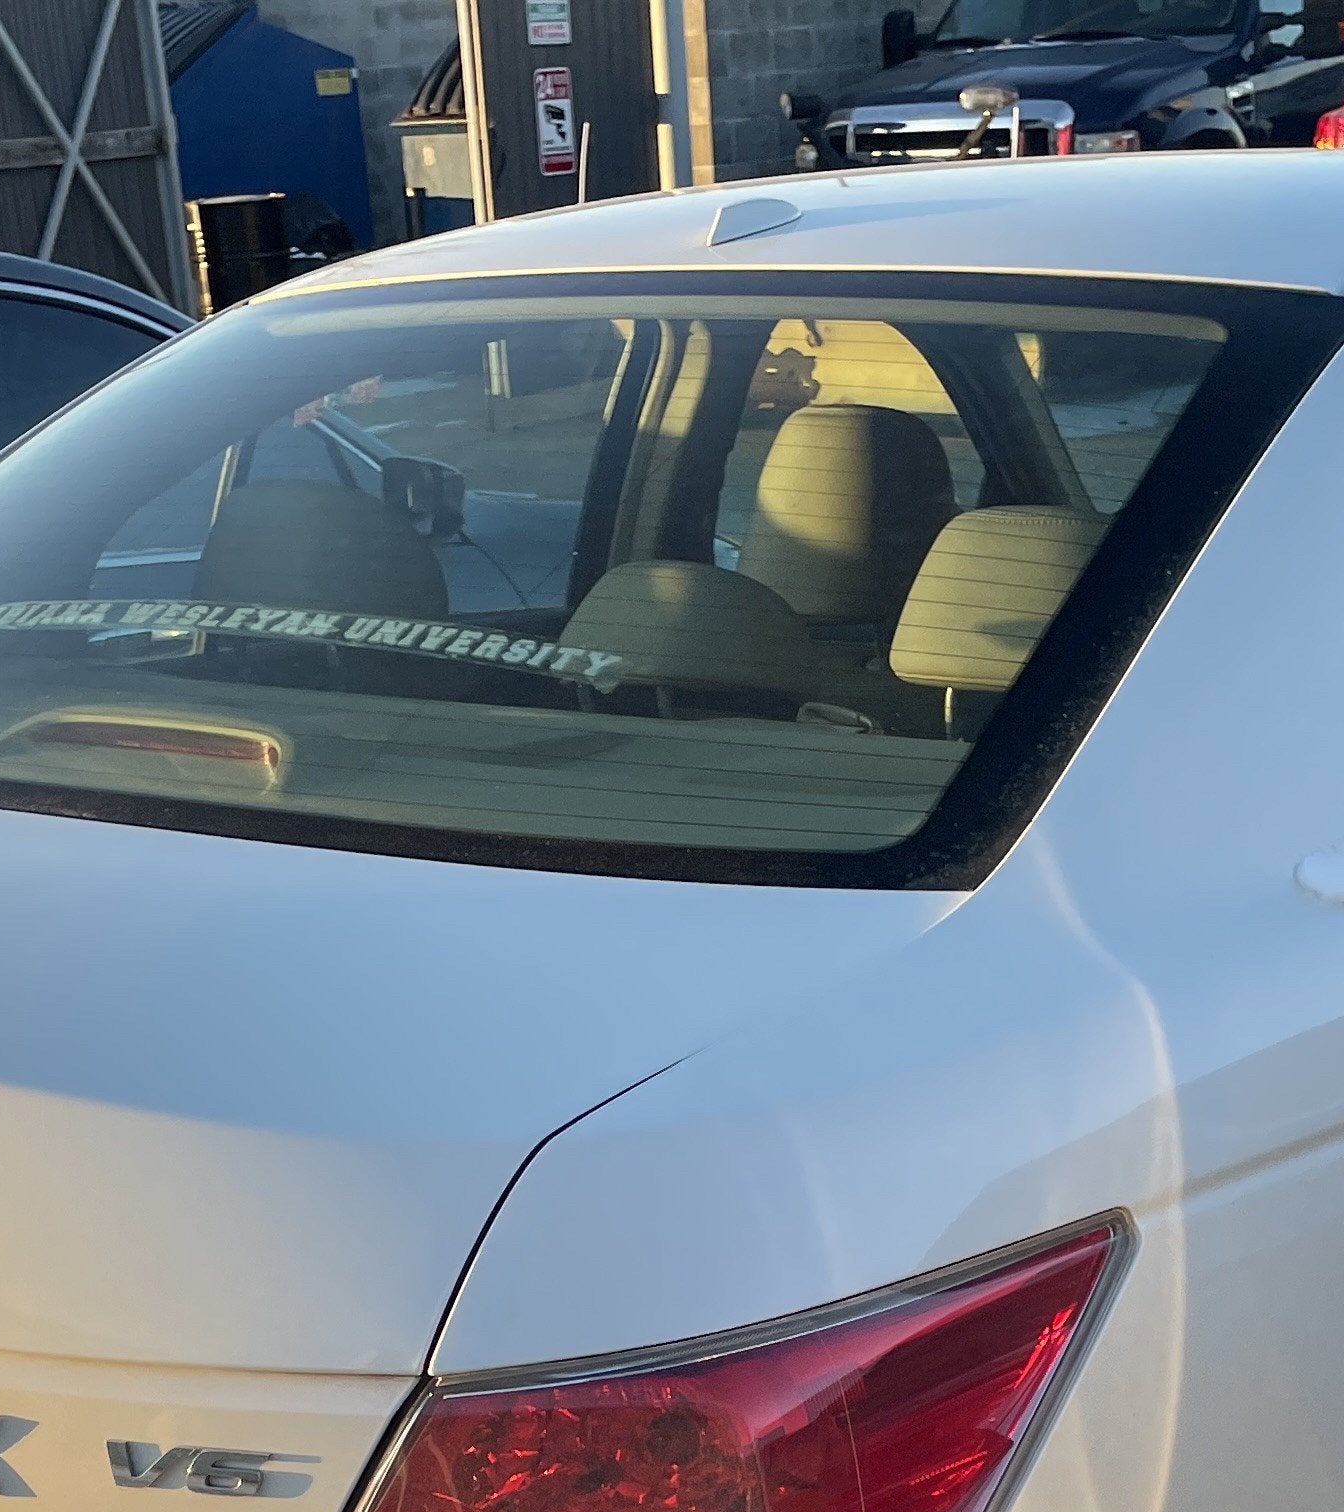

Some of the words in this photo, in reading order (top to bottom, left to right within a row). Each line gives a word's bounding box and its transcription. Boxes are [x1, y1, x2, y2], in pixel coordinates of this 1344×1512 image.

[118, 602, 342, 637] WESLEYAN
[343, 617, 623, 678] UNIVERSITY
[106, 1438, 273, 1497] V6
